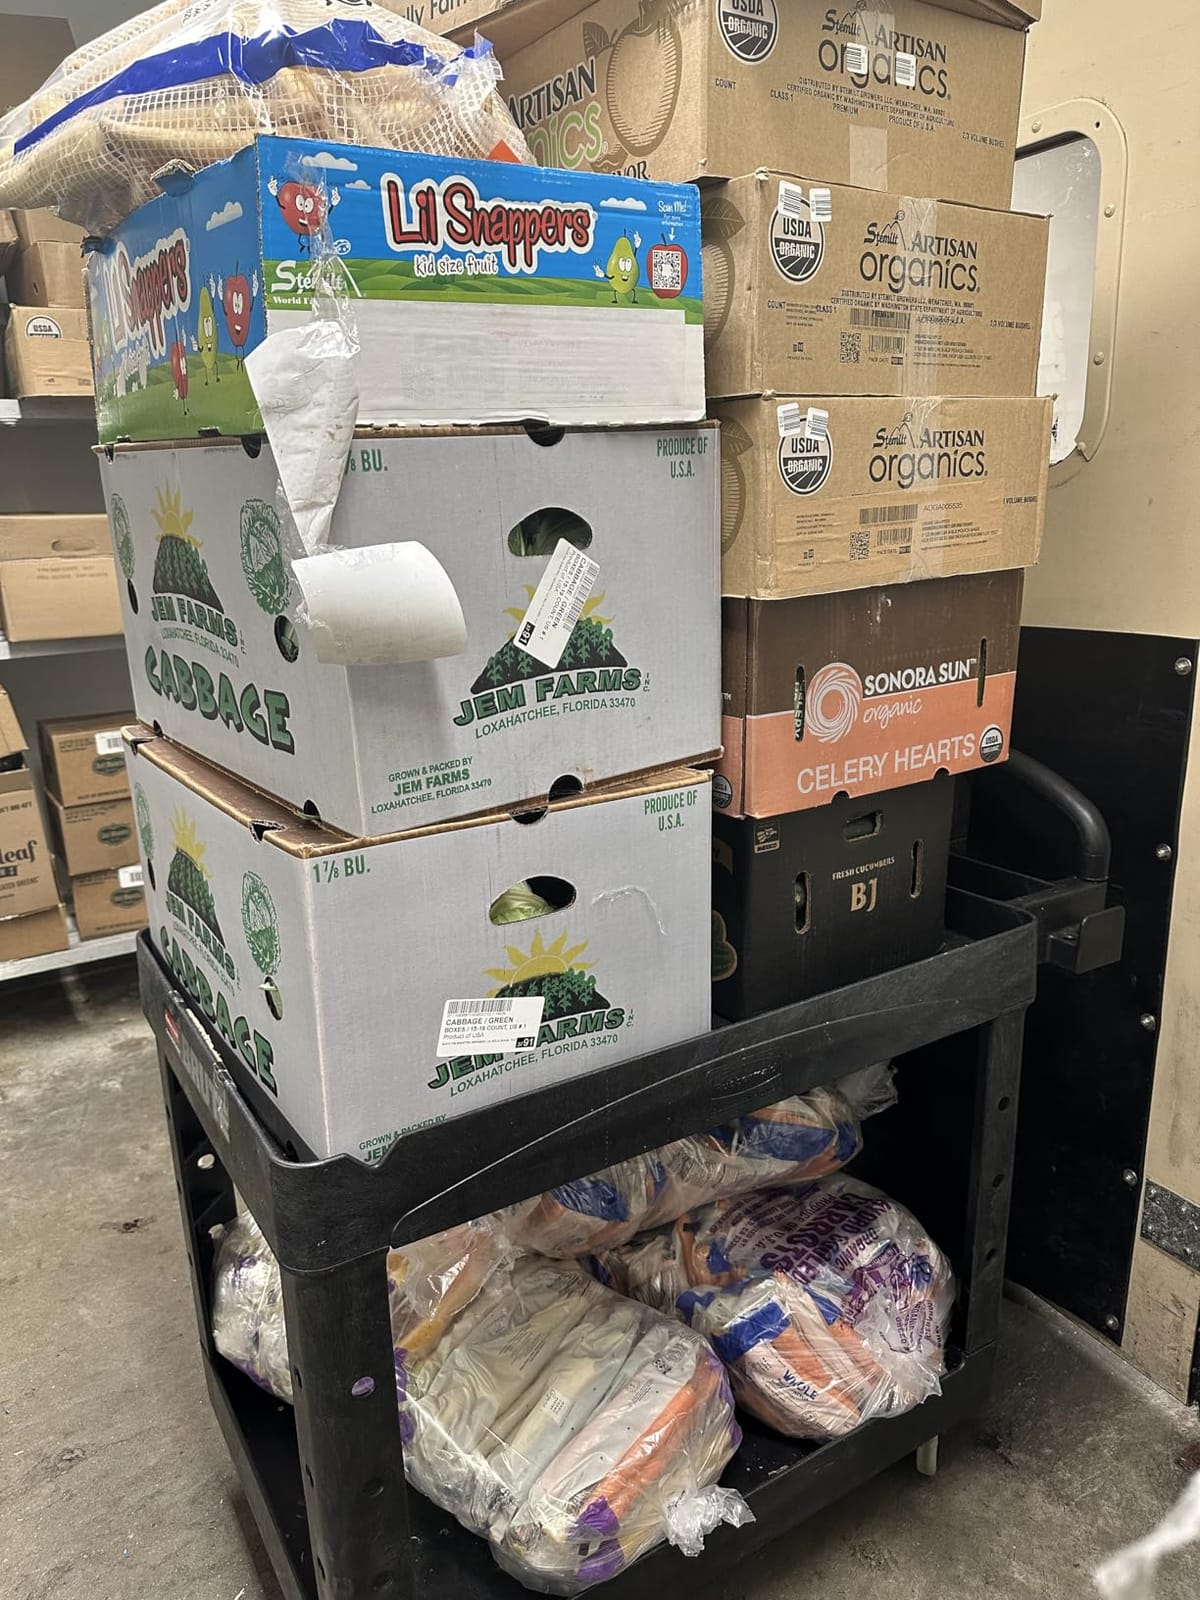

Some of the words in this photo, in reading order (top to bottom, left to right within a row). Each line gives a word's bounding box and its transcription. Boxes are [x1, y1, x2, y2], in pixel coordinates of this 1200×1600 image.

[727, 16, 769, 39] ORGANIC
[875, 24, 947, 64] ARTISAN
[715, 78, 737, 90] COUNT
[770, 89, 789, 101] CLASS
[786, 83, 813, 95] CERTIFIED
[813, 89, 835, 100] ORGANIC
[832, 102, 858, 115] PREMIUM
[888, 115, 912, 127] PRODUCE
[386, 179, 438, 246] Lil
[443, 181, 591, 267] Snappers
[783, 218, 812, 239] USDA
[779, 241, 816, 260] ORGANIC
[911, 230, 978, 260] ARTISAN
[439, 257, 463, 275] size
[466, 253, 499, 275] fruit
[816, 305, 832, 313] CLASS
[656, 437, 695, 457] PRODUCE
[697, 436, 709, 455] OF
[791, 437, 820, 454] USDA
[920, 428, 985, 449] ARTISAN
[361, 449, 388, 472] BU.
[670, 460, 696, 479] U.S.A.
[787, 458, 823, 473] ORGANIC
[151, 596, 178, 622] JEM
[177, 597, 238, 647] FARMS
[551, 601, 568, 630] GREEN
[864, 667, 936, 697] SONORA
[145, 645, 295, 755] CABBAGE
[453, 684, 526, 727] JEM
[535, 668, 642, 703] FARMS
[475, 704, 560, 739] LOXAHATCHEE,
[562, 697, 608, 714] FLORIDA
[609, 697, 636, 708] 33470
[863, 695, 922, 729] organic
[388, 768, 420, 783] GROWN
[421, 766, 428, 776] &
[429, 759, 461, 774] PACKED
[462, 756, 473, 766] BY
[797, 751, 889, 794] CELERY
[894, 733, 976, 773] HEARTS
[371, 791, 435, 814] LOXAHATCHEE,
[436, 783, 470, 798] FLORIDA
[471, 778, 493, 791] 33470
[393, 779, 422, 797] JEM
[425, 768, 470, 789] FARMS
[644, 792, 685, 816] PRODUCE
[686, 789, 698, 806] OF
[658, 812, 685, 832] U.S.A.
[343, 855, 371, 877] BU.
[832, 869, 854, 881] FRESH
[855, 856, 896, 875] CUCUMBERS
[850, 878, 878, 912] BJ
[160, 925, 278, 1098] CABBAGE
[446, 1017, 482, 1026] CABBAGE
[488, 1016, 514, 1024] GREEN
[536, 1008, 625, 1048] ARMS
[450, 1052, 538, 1097] LOXAHATCHEE,
[541, 1039, 588, 1060] FLORIDA
[590, 1034, 618, 1047] 33470
[359, 1132, 392, 1150] GROWN
[794, 1193, 836, 1223] PRODUCE
[759, 1194, 870, 1272] CARROTS
[833, 1227, 879, 1272] ORGANIC
